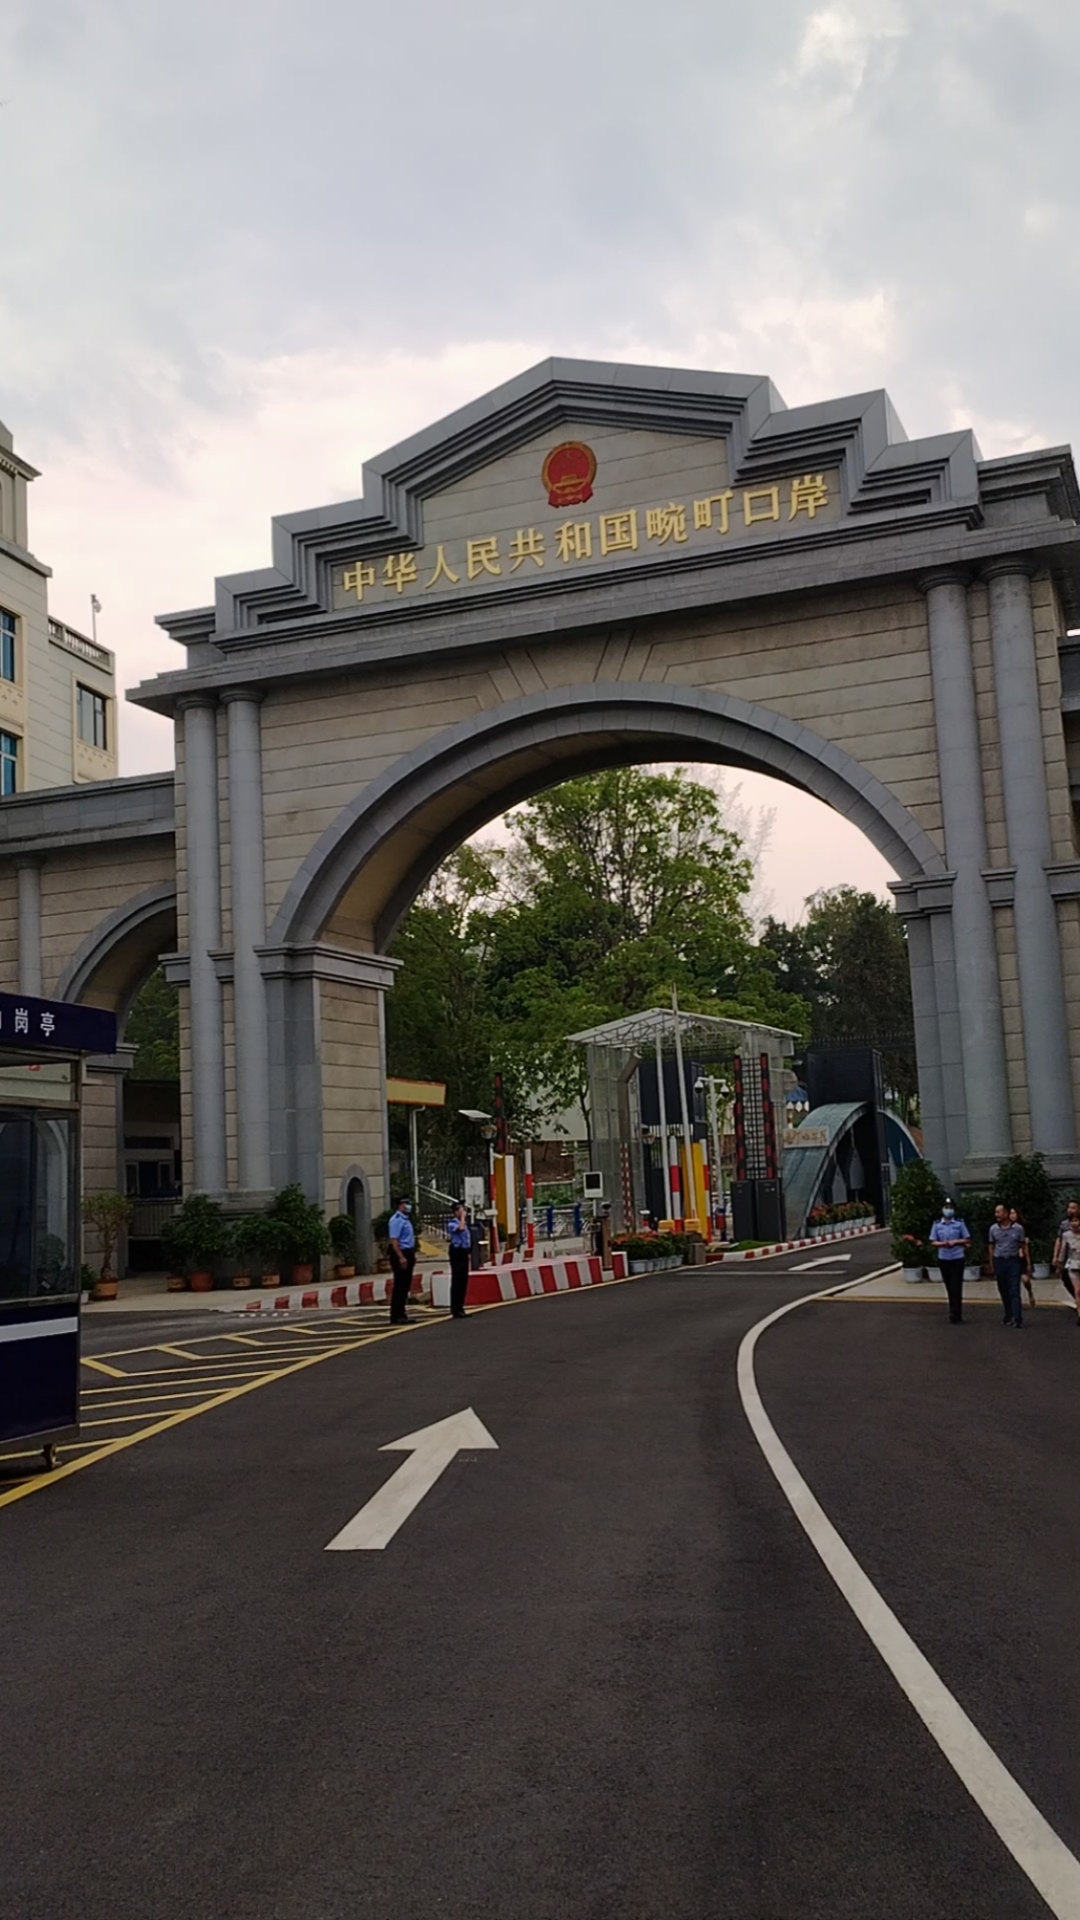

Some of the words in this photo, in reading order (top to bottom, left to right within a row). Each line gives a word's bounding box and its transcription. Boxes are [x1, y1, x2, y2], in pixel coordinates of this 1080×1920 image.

[342, 474, 829, 601] 中华人民共和国畹町口岸
[0, 1007, 55, 1037] 岗亭
